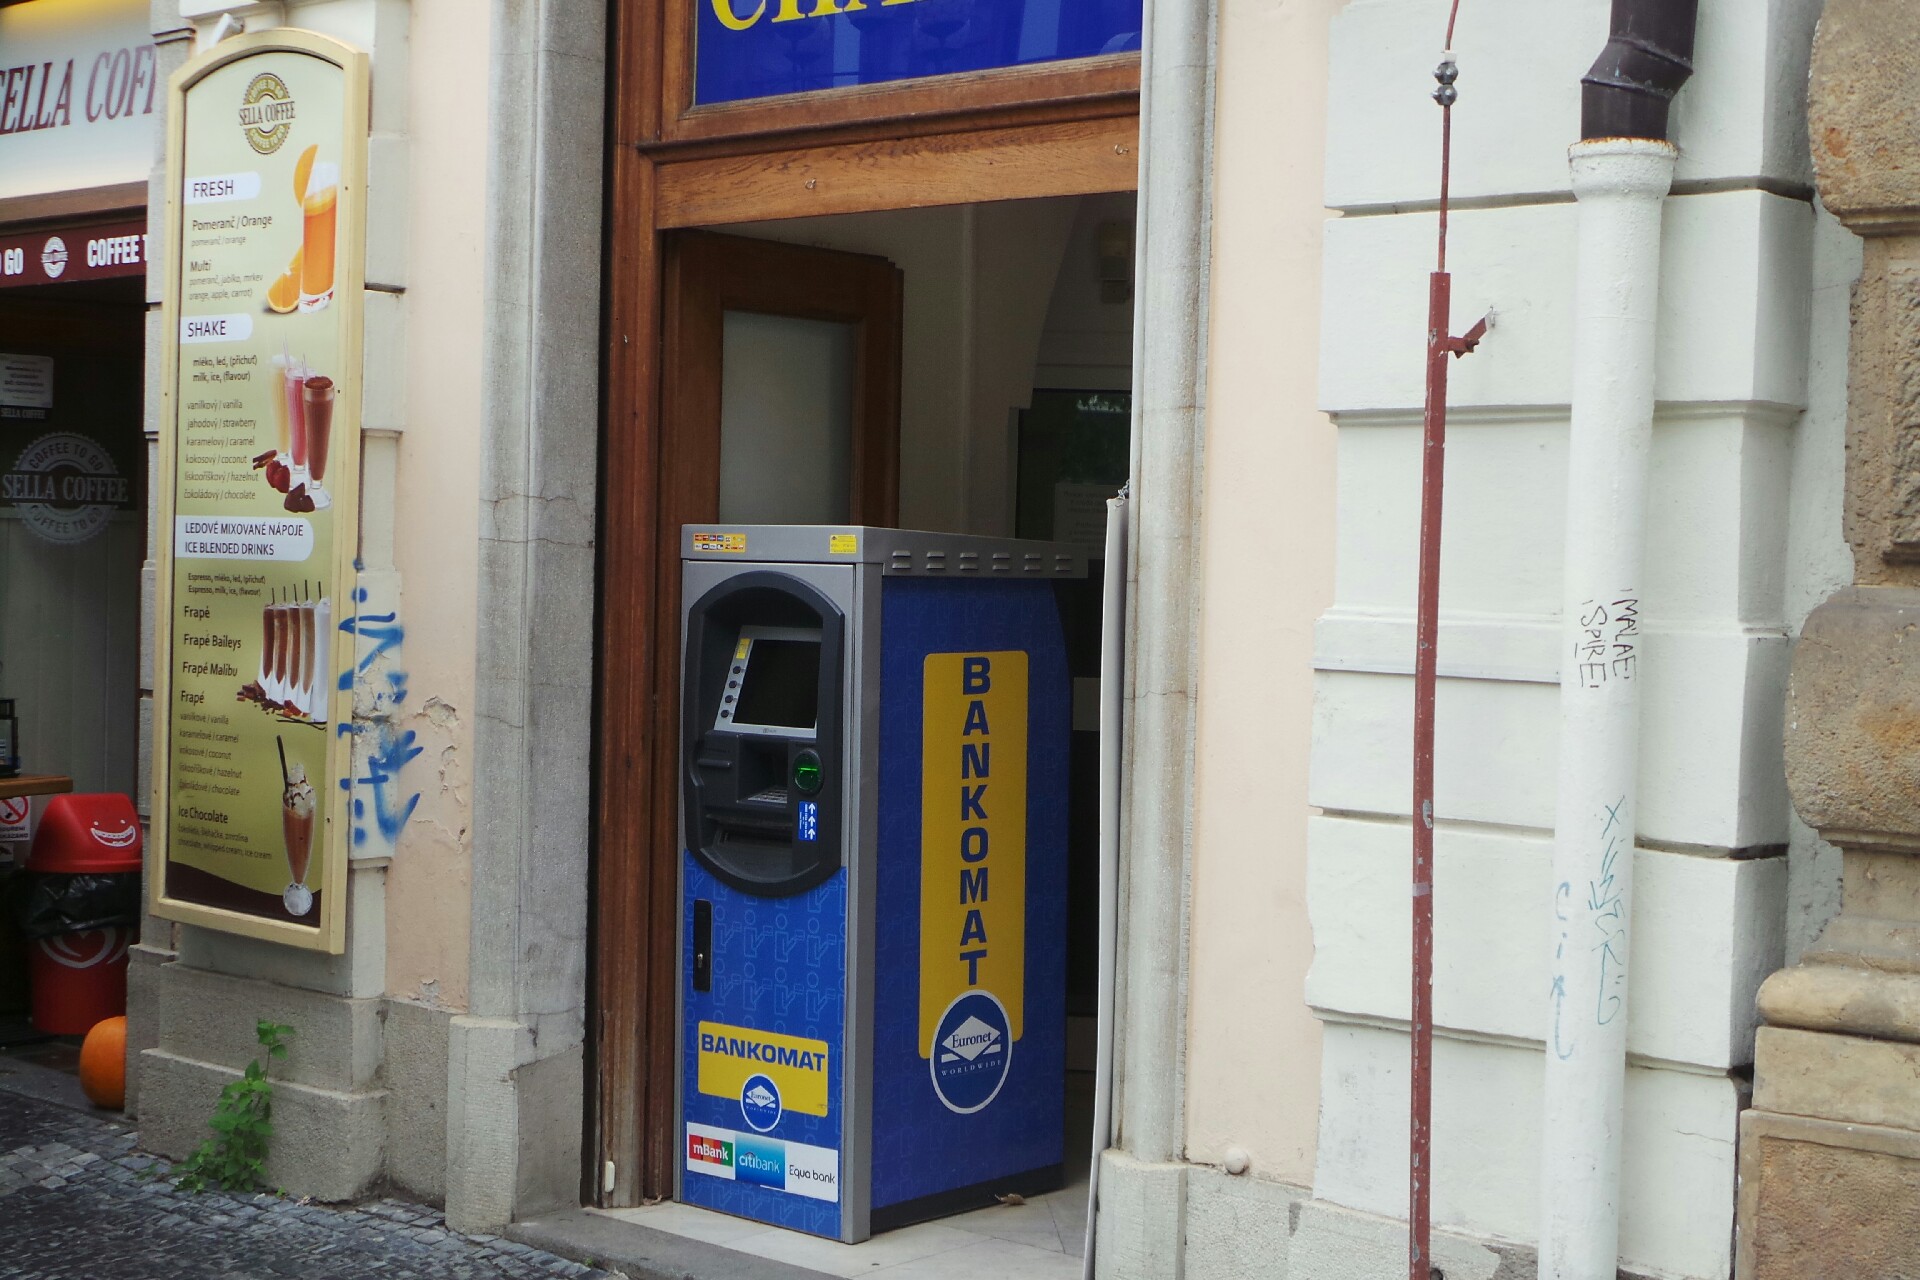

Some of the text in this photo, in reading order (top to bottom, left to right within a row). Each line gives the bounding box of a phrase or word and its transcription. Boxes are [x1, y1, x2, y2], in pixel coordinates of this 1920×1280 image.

[0, 58, 73, 135] ELLA
[239, 101, 295, 126] SELLA COFFEE
[193, 179, 234, 198] FRESH
[192, 216, 235, 231] Pomeranč
[241, 215, 272, 229] Orange
[87, 235, 140, 268] COFFEE
[4, 248, 24, 275] GO
[190, 259, 212, 272] Multi
[187, 320, 227, 338] SHAKE
[223, 371, 251, 383] (flavour)
[222, 399, 243, 409] vanilla
[187, 417, 218, 430] jahodový
[222, 418, 256, 429] strawberry
[230, 436, 255, 446] caramel
[29, 442, 104, 470] COFFEE TO GO
[185, 454, 217, 465] kokosový
[221, 455, 247, 464] coconut
[231, 472, 259, 482] hazelnut
[2, 474, 129, 502] SELLA COFFEE
[224, 489, 256, 500] chocolate
[185, 521, 304, 536] LEDOVÉ MIXOVANÉ NÁPOJE
[185, 542, 274, 556] ICE BLENDED DRINKS
[184, 605, 210, 621] Frapé
[184, 633, 242, 650] Frapé Baileys
[182, 661, 238, 677] Frapé Malibu
[181, 690, 205, 705] Frapé
[212, 784, 240, 796] chocolate
[178, 804, 228, 824] Ice Chocolate
[959, 656, 991, 986] BANKOMAT
[952, 1031, 992, 1048] Euronet
[701, 1033, 826, 1072] BANKOMAT
[941, 1060, 1002, 1077] WORLDWIDE
[693, 1142, 729, 1161] mBank
[739, 1153, 780, 1174] citibank
[789, 1165, 836, 1184] Equa bank
